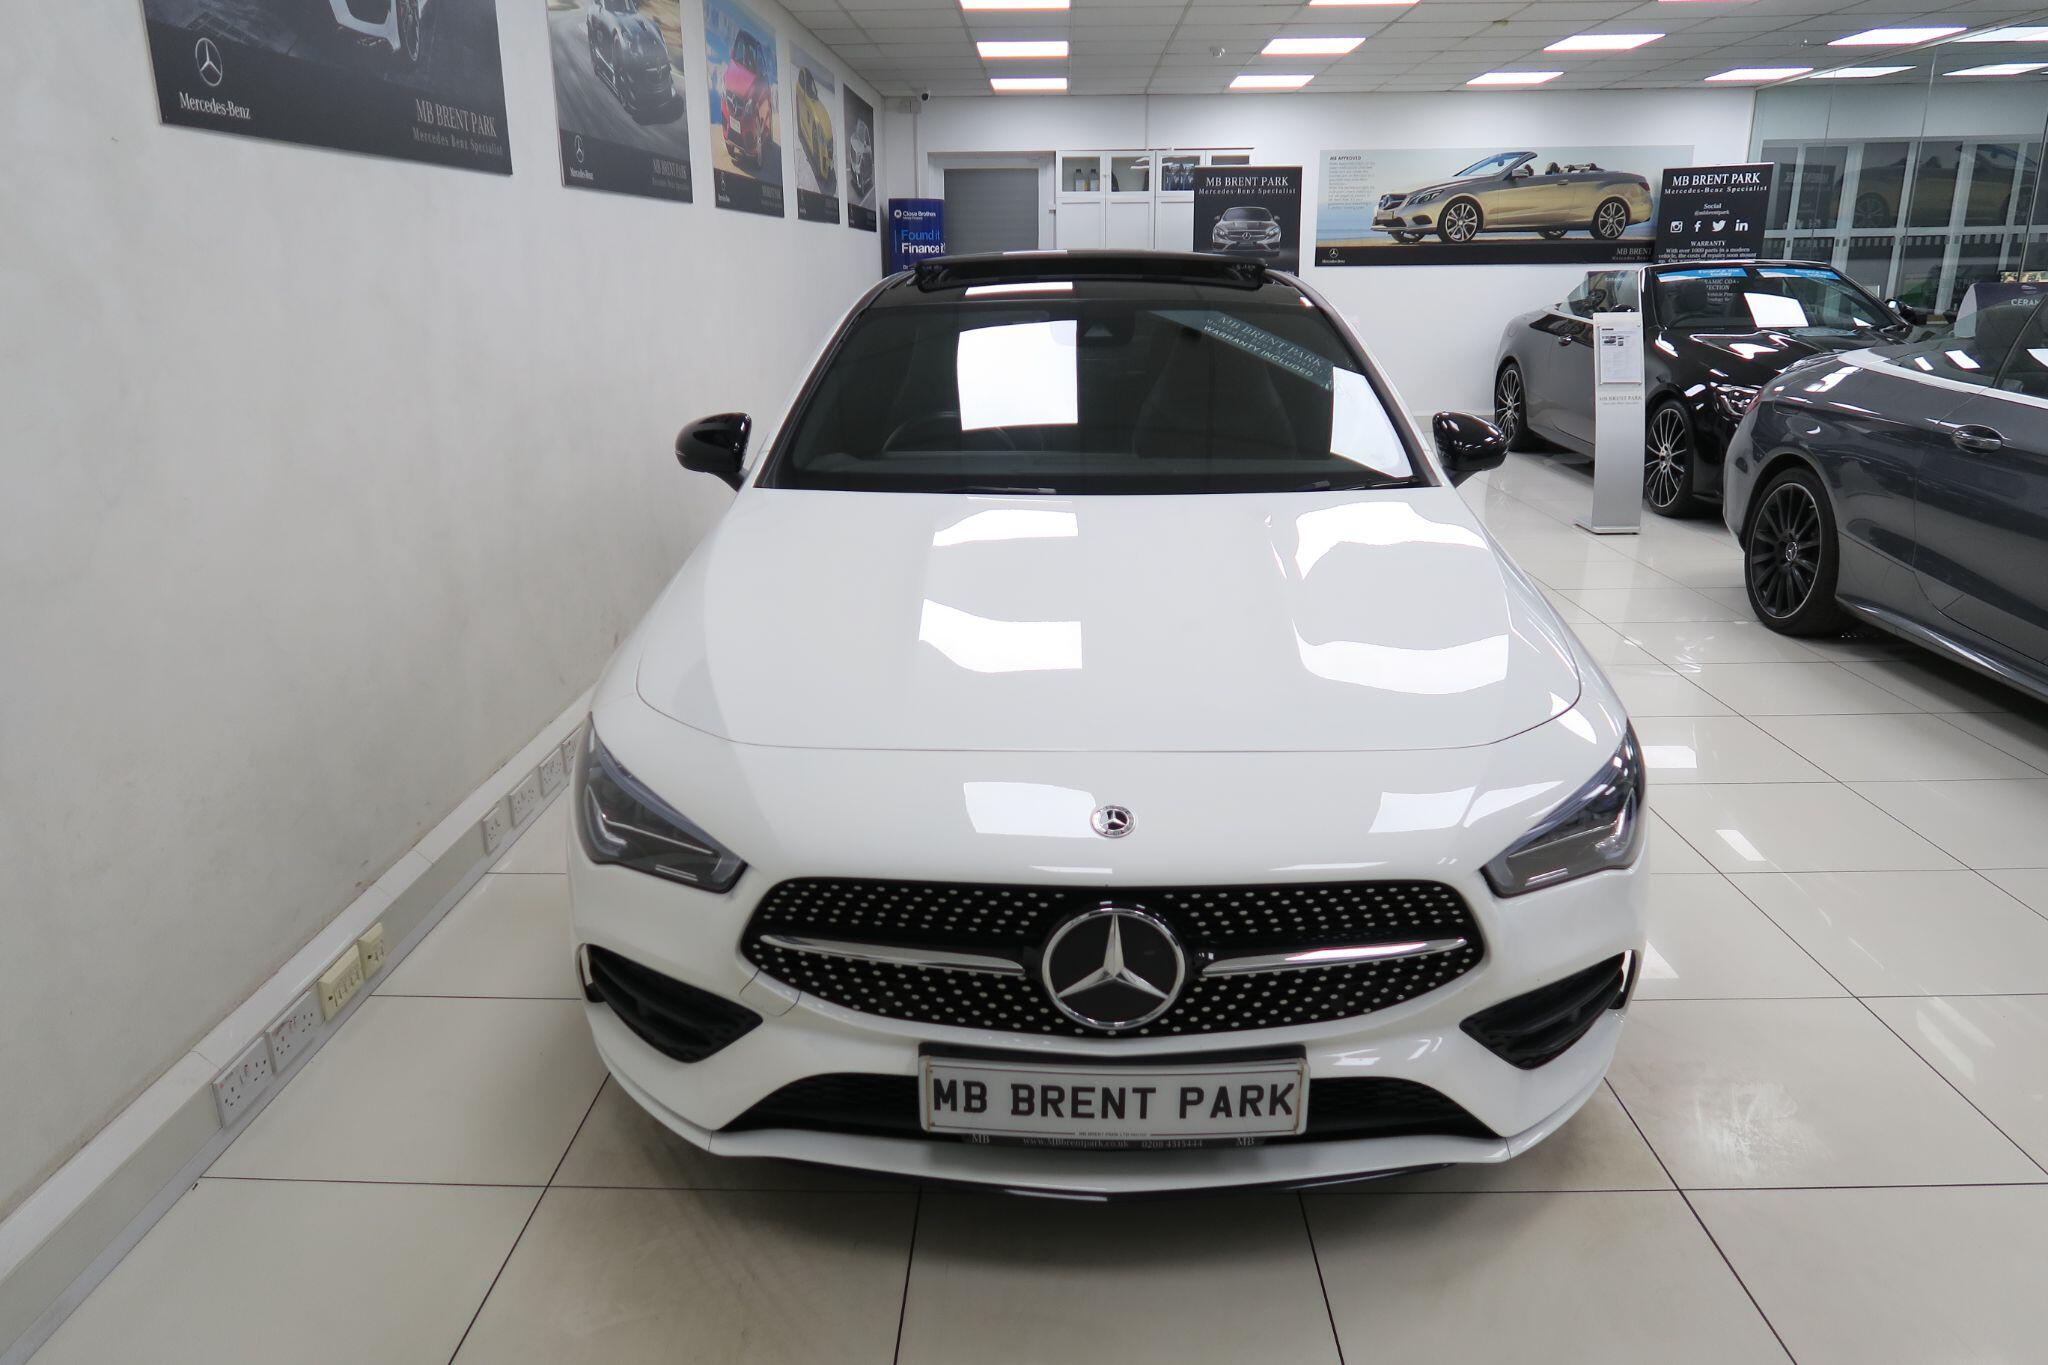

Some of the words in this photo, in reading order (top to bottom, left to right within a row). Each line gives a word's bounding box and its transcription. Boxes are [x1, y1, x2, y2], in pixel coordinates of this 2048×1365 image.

[180, 91, 251, 119] Mercedes-Benz
[416, 98, 434, 124] MB
[435, 103, 469, 132] BRENT
[470, 111, 497, 137] PARK
[1206, 177, 1221, 187] MB
[1225, 176, 1258, 187] BRENT
[1261, 176, 1288, 186] PARK
[1672, 175, 1689, 187] MB
[1692, 173, 1729, 186] BRENT
[1731, 172, 1760, 184] PARK
[1258, 188, 1296, 196] Specialist
[1727, 185, 1767, 194] Specialist
[901, 229, 934, 241] Found
[901, 242, 939, 254] Finance
[1241, 326, 1288, 350] BRENT
[1204, 326, 1261, 352] WARRANTY
[1260, 350, 1314, 377] INCLUDED
[933, 1077, 988, 1113] MB
[1010, 1083, 1156, 1120] BRENT
[1179, 1083, 1295, 1120] PARK
[971, 1134, 990, 1144] MB
[1237, 1136, 1255, 1147] MB
